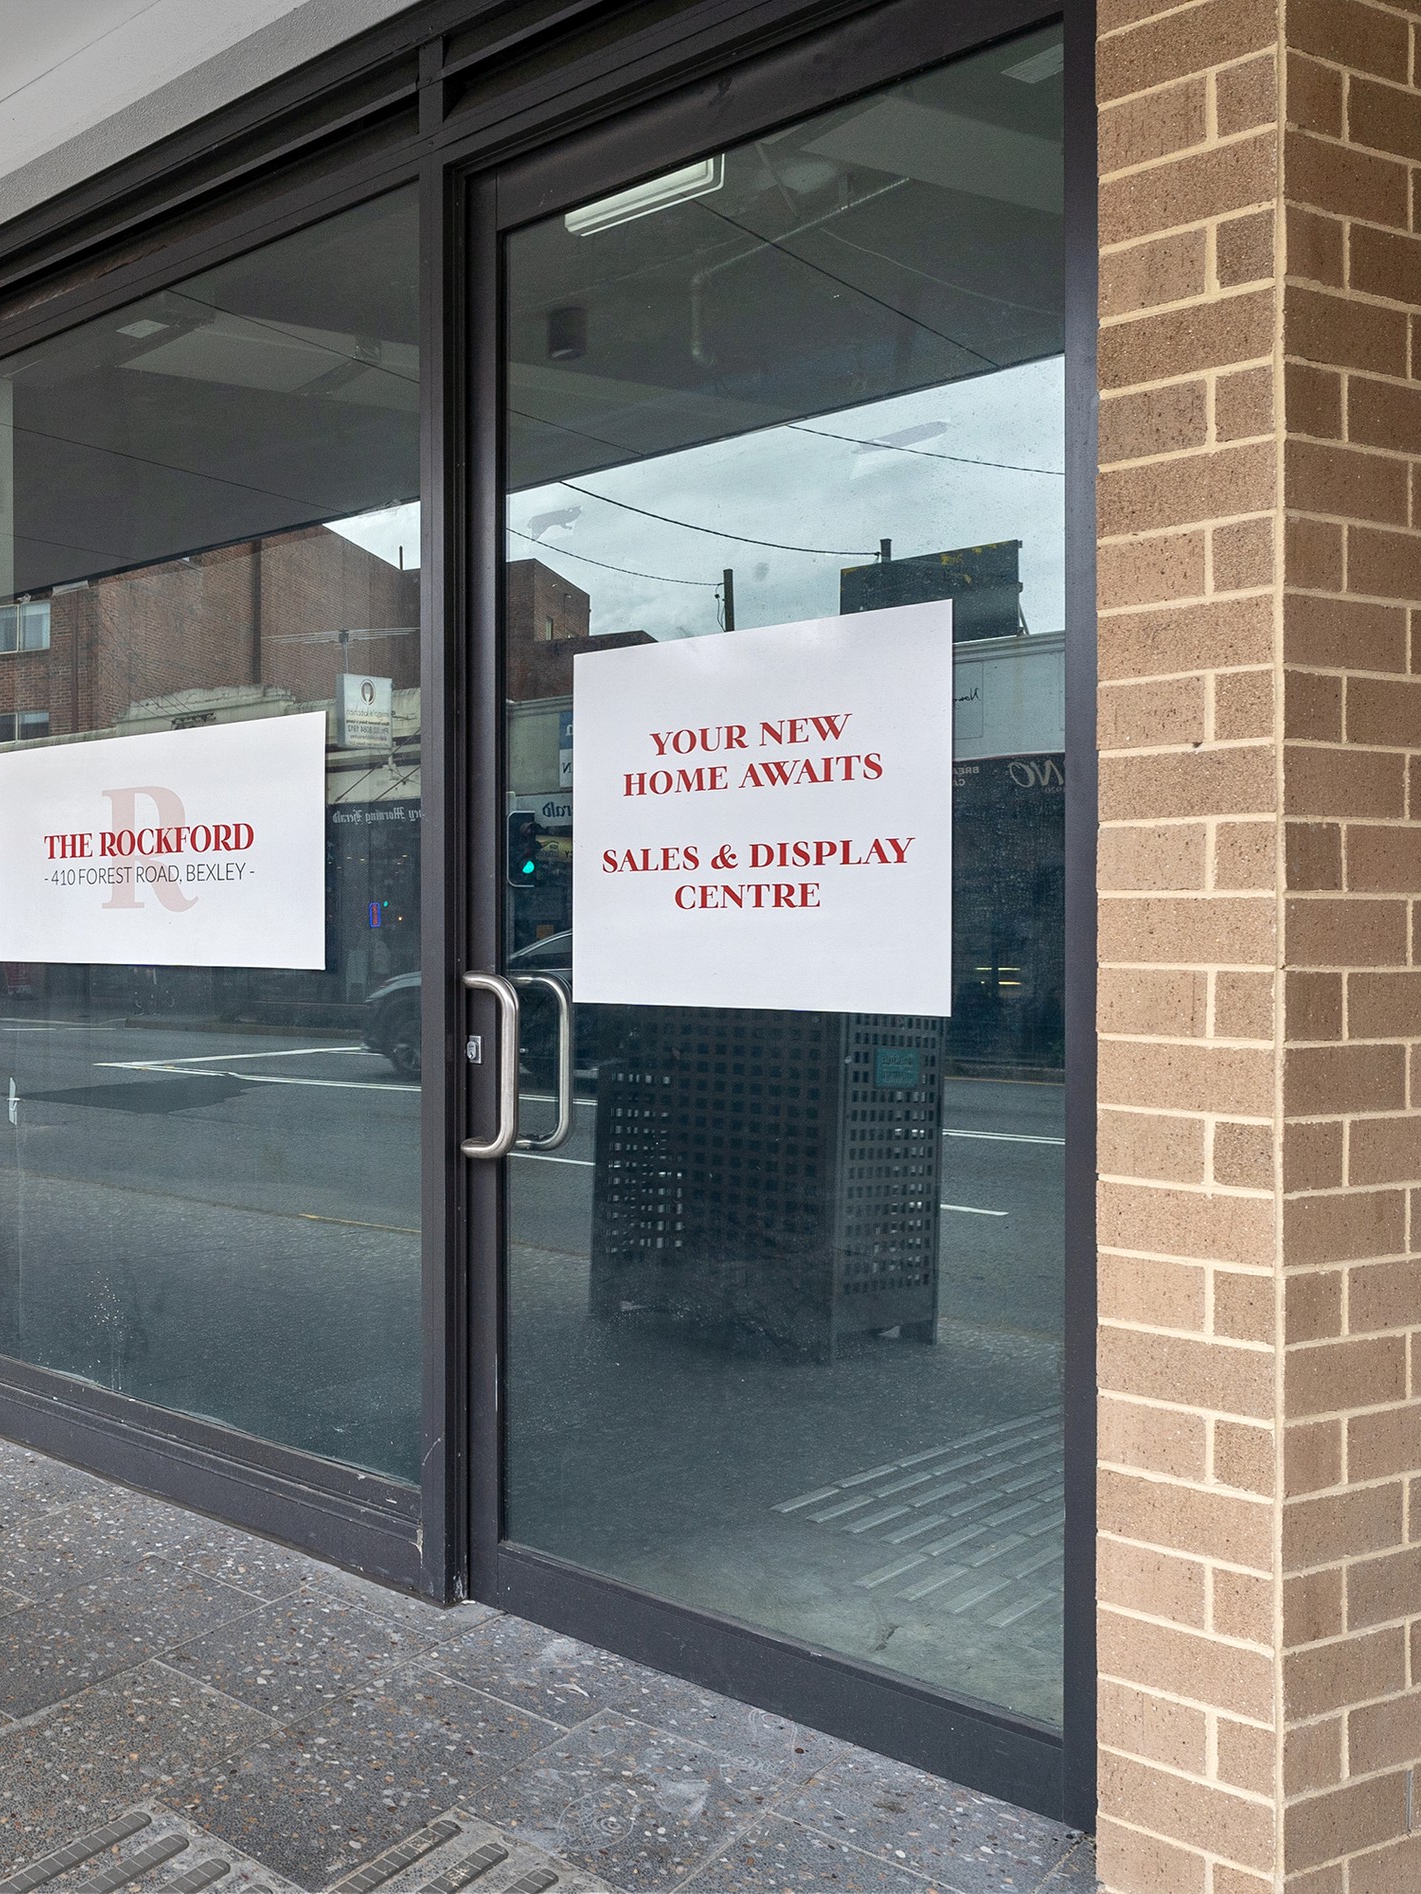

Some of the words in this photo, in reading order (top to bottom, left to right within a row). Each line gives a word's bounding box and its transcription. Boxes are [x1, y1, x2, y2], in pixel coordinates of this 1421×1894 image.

[650, 724, 747, 756] YOUR
[759, 713, 852, 746] NEW
[623, 766, 728, 797] HOME
[739, 752, 883, 791] AWAITS
[44, 832, 93, 860] THE
[99, 823, 254, 857] ROCKFORD
[602, 845, 699, 874] SALES
[712, 844, 738, 870] &
[749, 837, 915, 868] DISPLAY
[52, 869, 75, 885] 410
[79, 867, 132, 884] FOREST
[137, 866, 182, 882] ROAD,
[187, 863, 245, 881] BEXLEY
[675, 882, 821, 910] CENTRE
